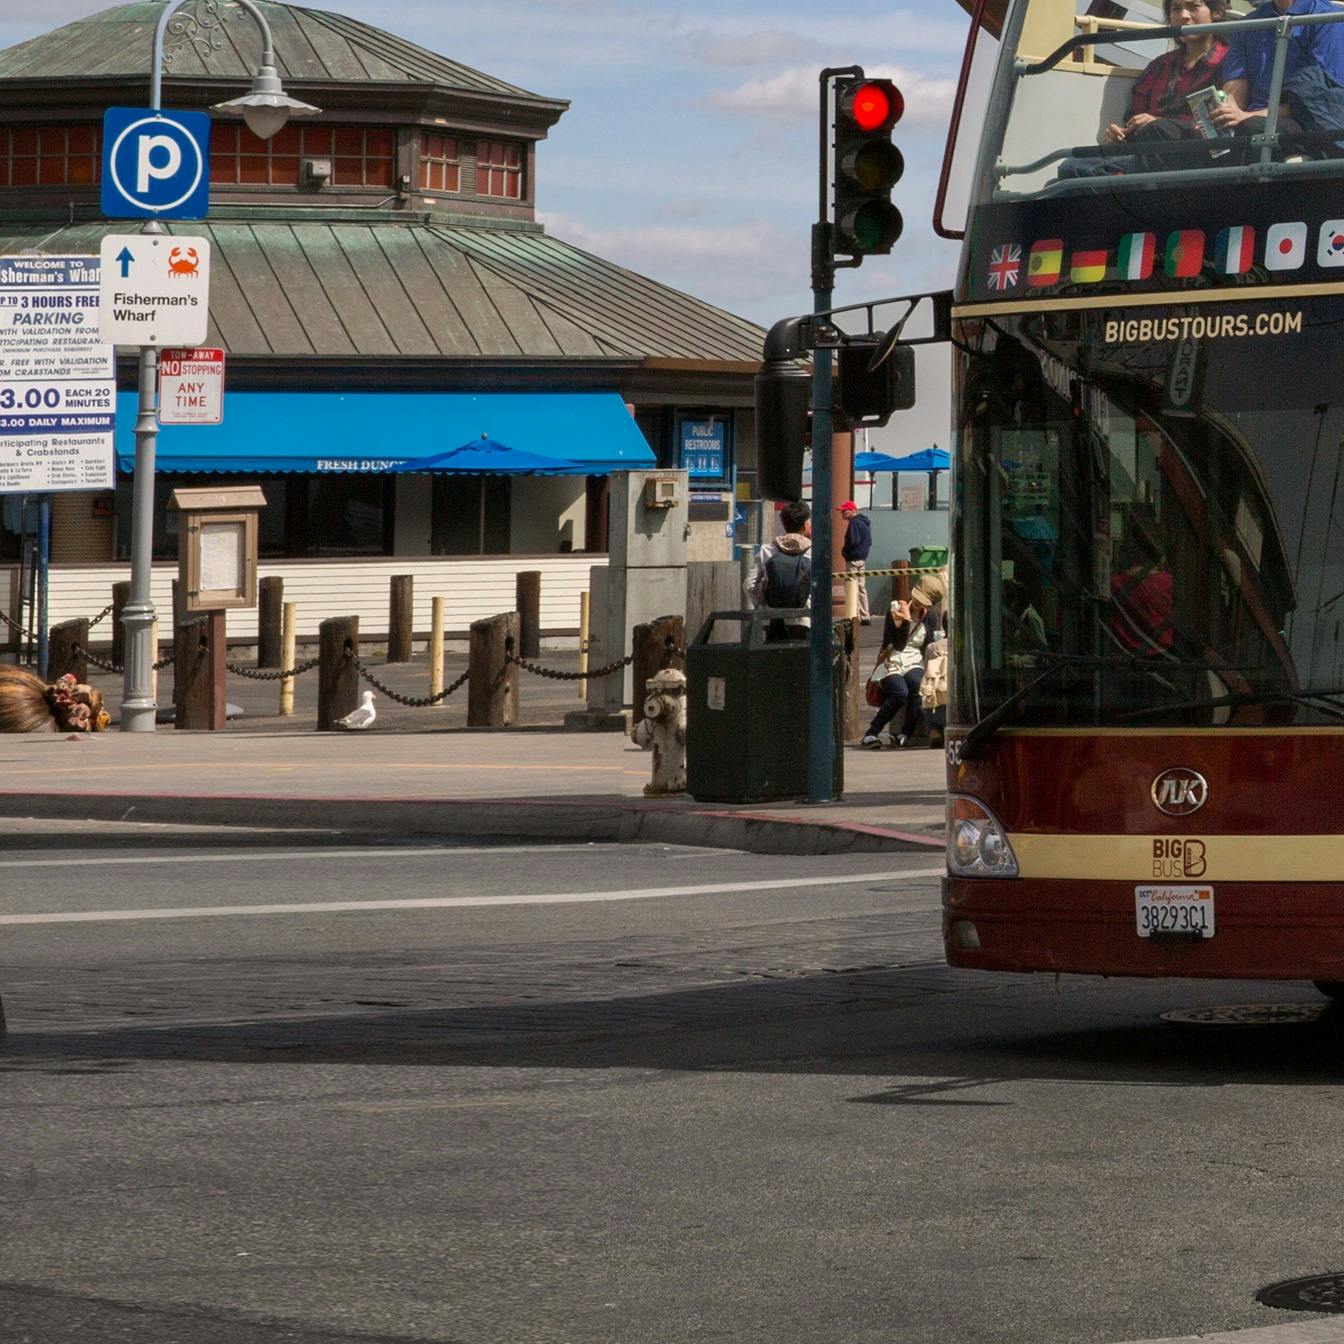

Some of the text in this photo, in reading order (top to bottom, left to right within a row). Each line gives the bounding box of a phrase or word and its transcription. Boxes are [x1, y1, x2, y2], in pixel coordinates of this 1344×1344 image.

[14, 260, 84, 269] WELCOME TO
[0, 267, 101, 284] sherman's Whar
[8, 296, 18, 305] TO
[21, 296, 29, 308] 3
[32, 296, 72, 308] HOURS
[114, 293, 198, 306] Fisherman's
[12, 312, 84, 326] PARKING
[114, 309, 157, 322] Wharf
[22, 328, 71, 336] VALIDATION
[75, 327, 99, 335] FROM
[1104, 312, 1302, 343] BIGBUSTOURS.COM
[52, 337, 103, 345] RESTAURAN
[170, 351, 215, 360] TOW-AWAY
[34, 358, 55, 366] WITH
[60, 357, 108, 365] VALIDATION
[15, 368, 71, 376] CRABSTANDS
[161, 361, 221, 376] NO STOPPING
[65, 389, 92, 397] EACH
[95, 388, 110, 396] 20
[178, 382, 205, 393] ANY
[65, 399, 111, 407] MINUTES
[175, 396, 207, 407] TIME
[29, 418, 57, 426] DAILY
[61, 417, 110, 425] MAXIMUM
[692, 426, 714, 436] PUBLIC
[0, 438, 105, 448] rticipating Restaurants
[684, 439, 720, 450] RESTROOMS
[27, 448, 80, 457] Crabstands
[317, 460, 358, 470] FRESH
[1153, 839, 1182, 858] BIG
[1153, 860, 1182, 878] BUS
[1151, 889, 1195, 904] California
[1141, 905, 1209, 929] 38293C1
